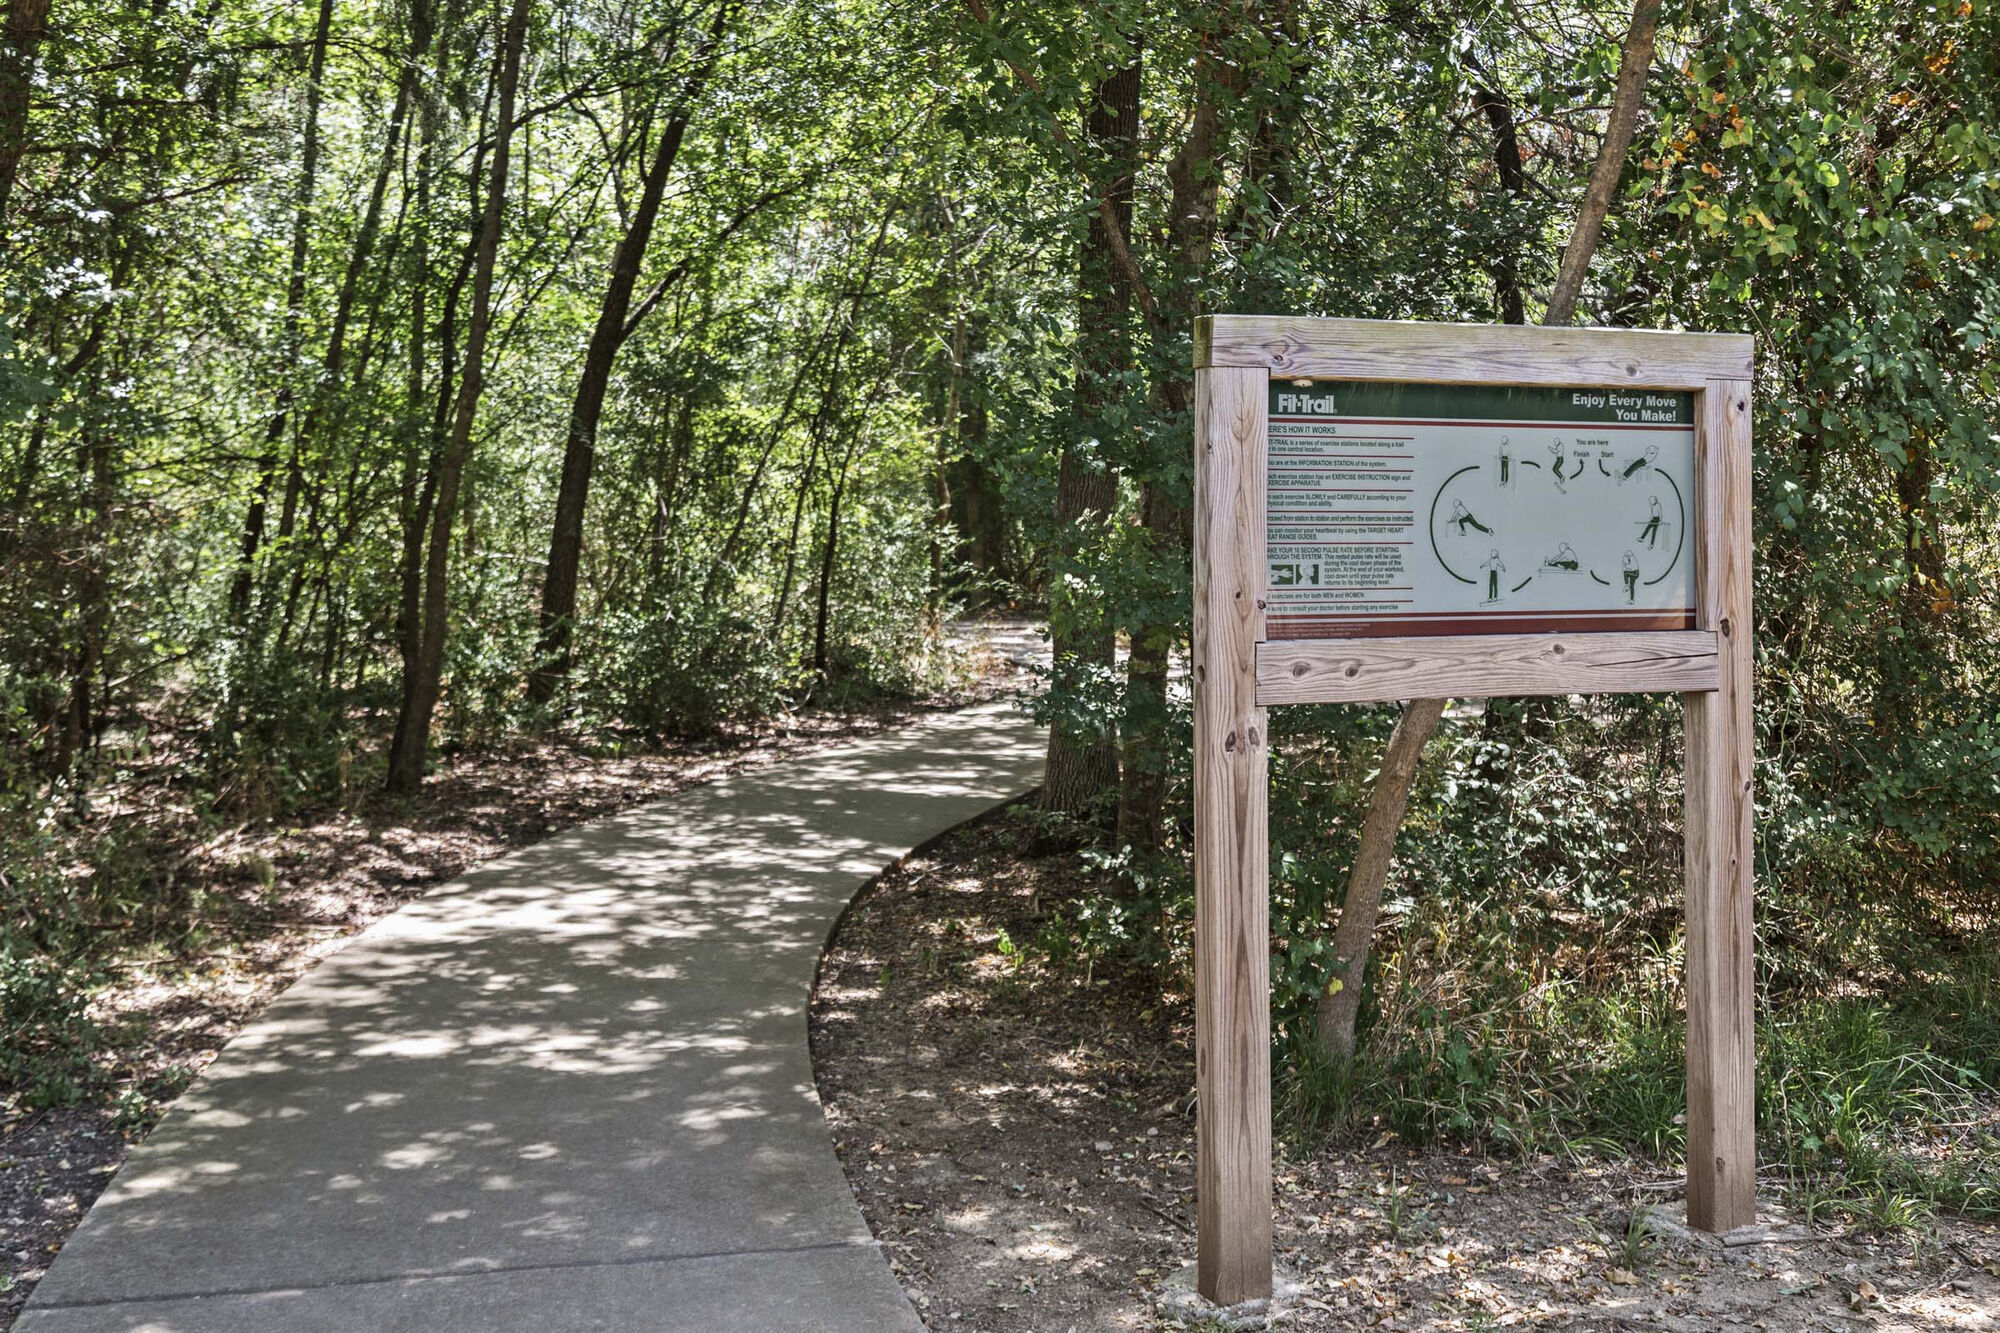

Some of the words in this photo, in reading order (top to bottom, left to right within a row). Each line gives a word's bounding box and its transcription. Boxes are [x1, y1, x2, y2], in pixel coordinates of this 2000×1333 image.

[1573, 393, 1605, 408] Enjoy
[1609, 395, 1642, 408] Every
[1646, 396, 1676, 407] Move
[1616, 409, 1637, 420] You
[1642, 410, 1676, 421] Make!
